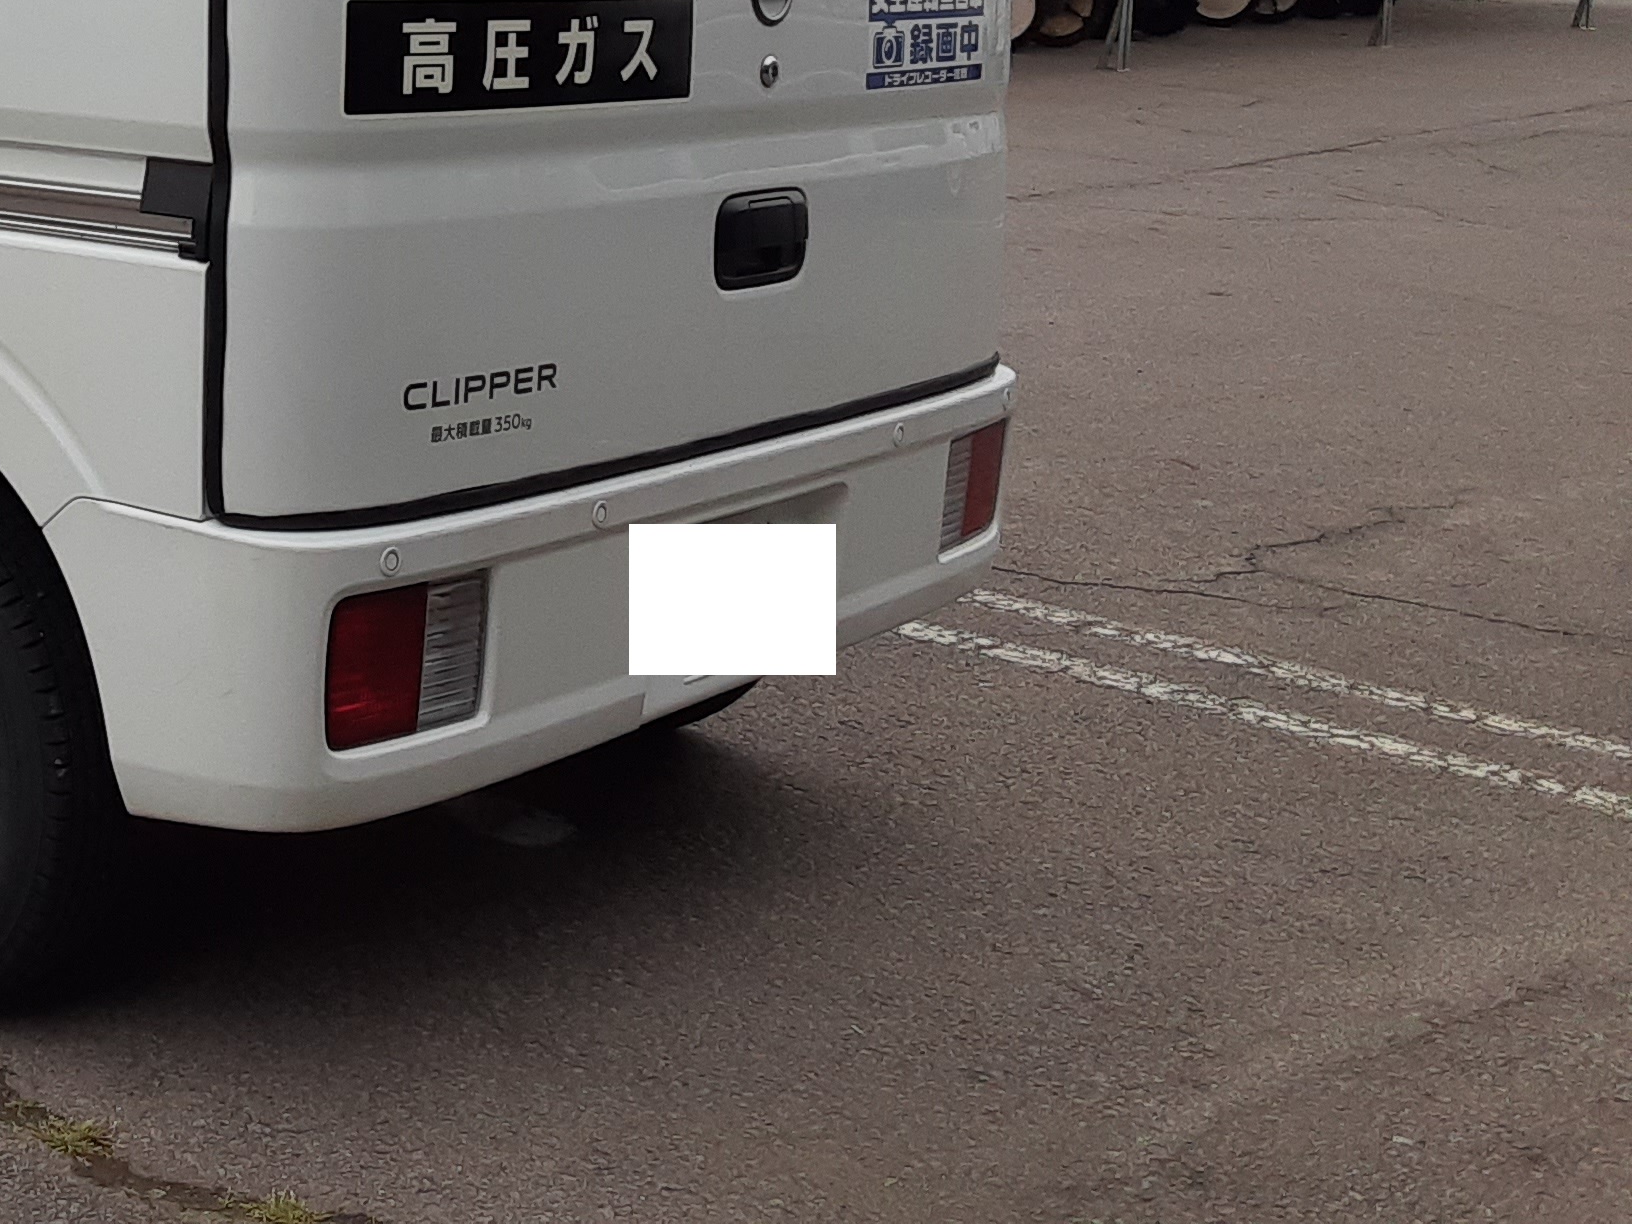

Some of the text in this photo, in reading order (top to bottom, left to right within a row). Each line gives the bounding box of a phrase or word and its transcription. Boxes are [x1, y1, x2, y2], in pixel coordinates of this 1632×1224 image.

[401, 15, 659, 95] 高圧ガス
[909, 20, 980, 64] 録画中
[403, 363, 558, 411] CLIPPER
